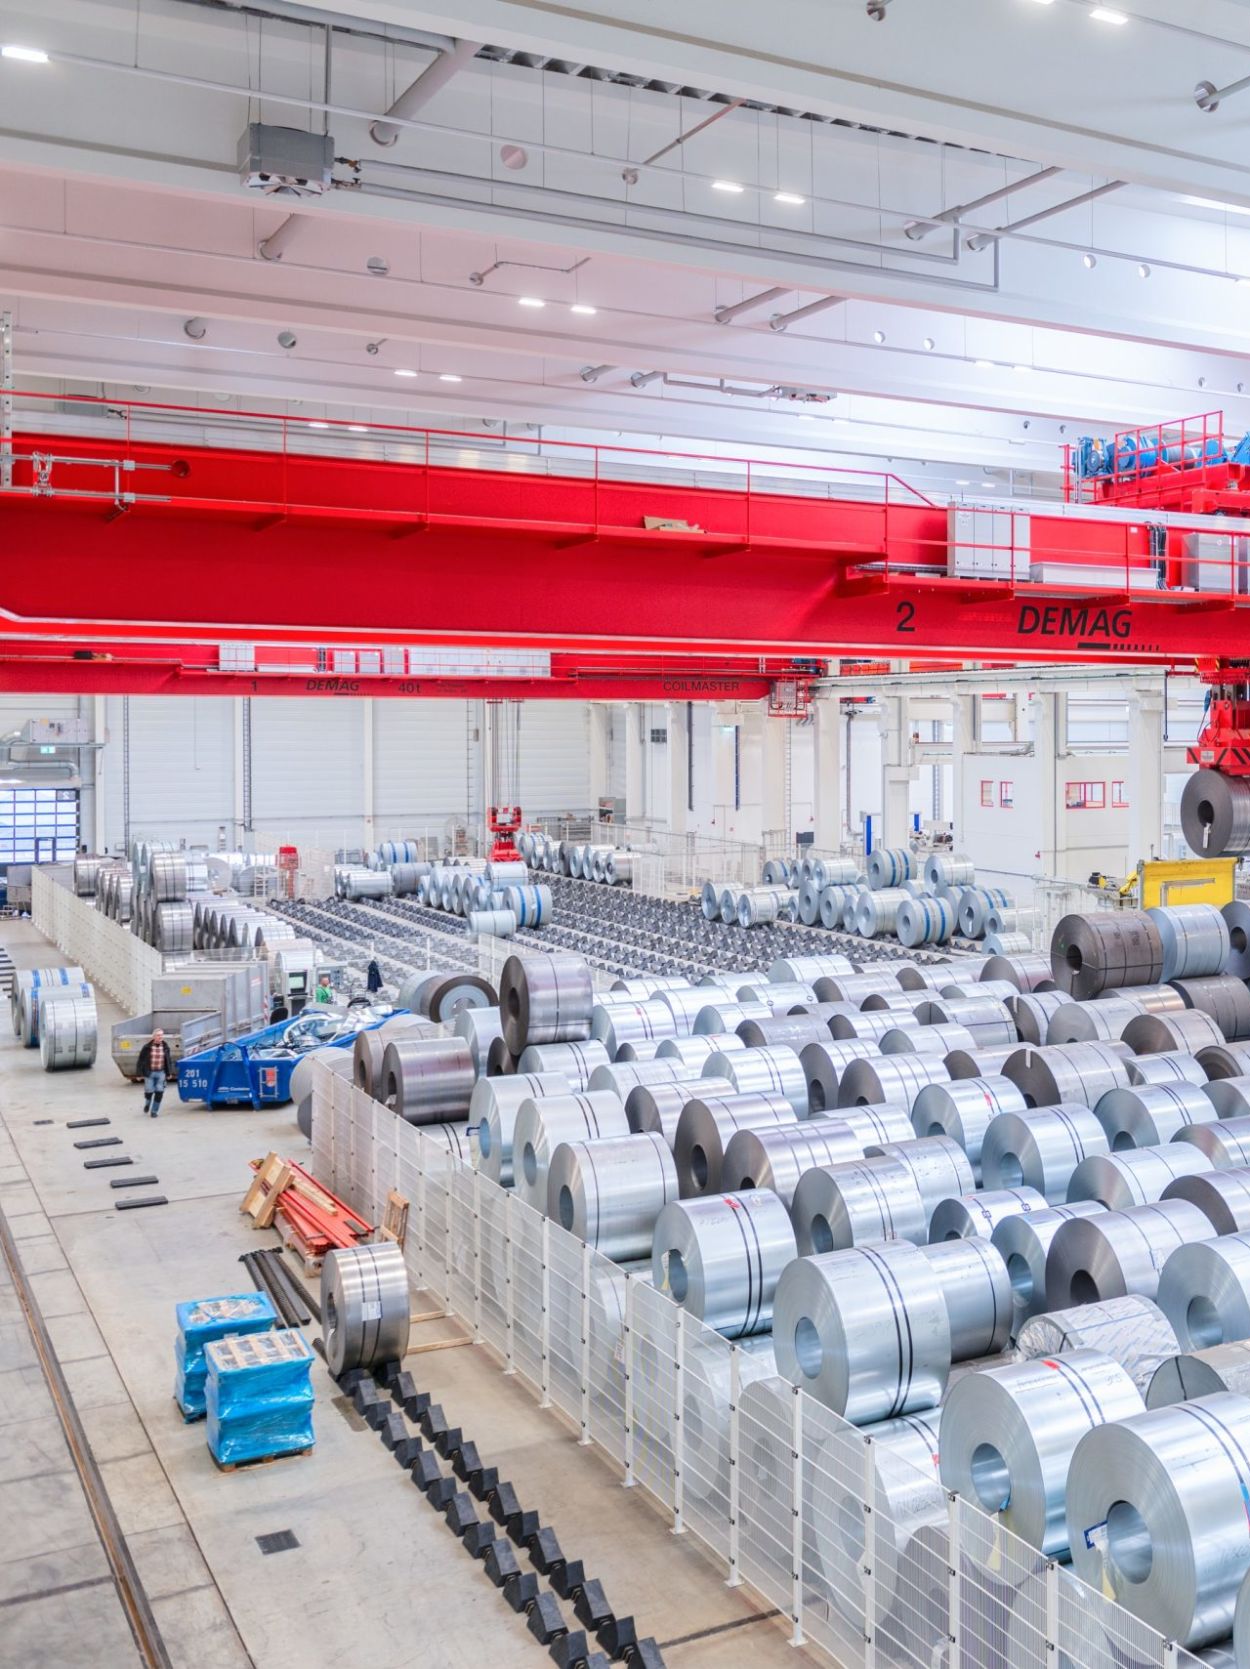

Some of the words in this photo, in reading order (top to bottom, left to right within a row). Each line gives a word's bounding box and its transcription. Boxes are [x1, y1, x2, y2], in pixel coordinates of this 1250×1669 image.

[896, 601, 916, 632] 2
[1017, 605, 1133, 638] DEMAG
[251, 681, 258, 692] 1
[305, 680, 360, 692] DEMAG
[663, 681, 740, 692] COILMASTER
[184, 1069, 200, 1078] 201
[192, 1079, 208, 1088] 510
